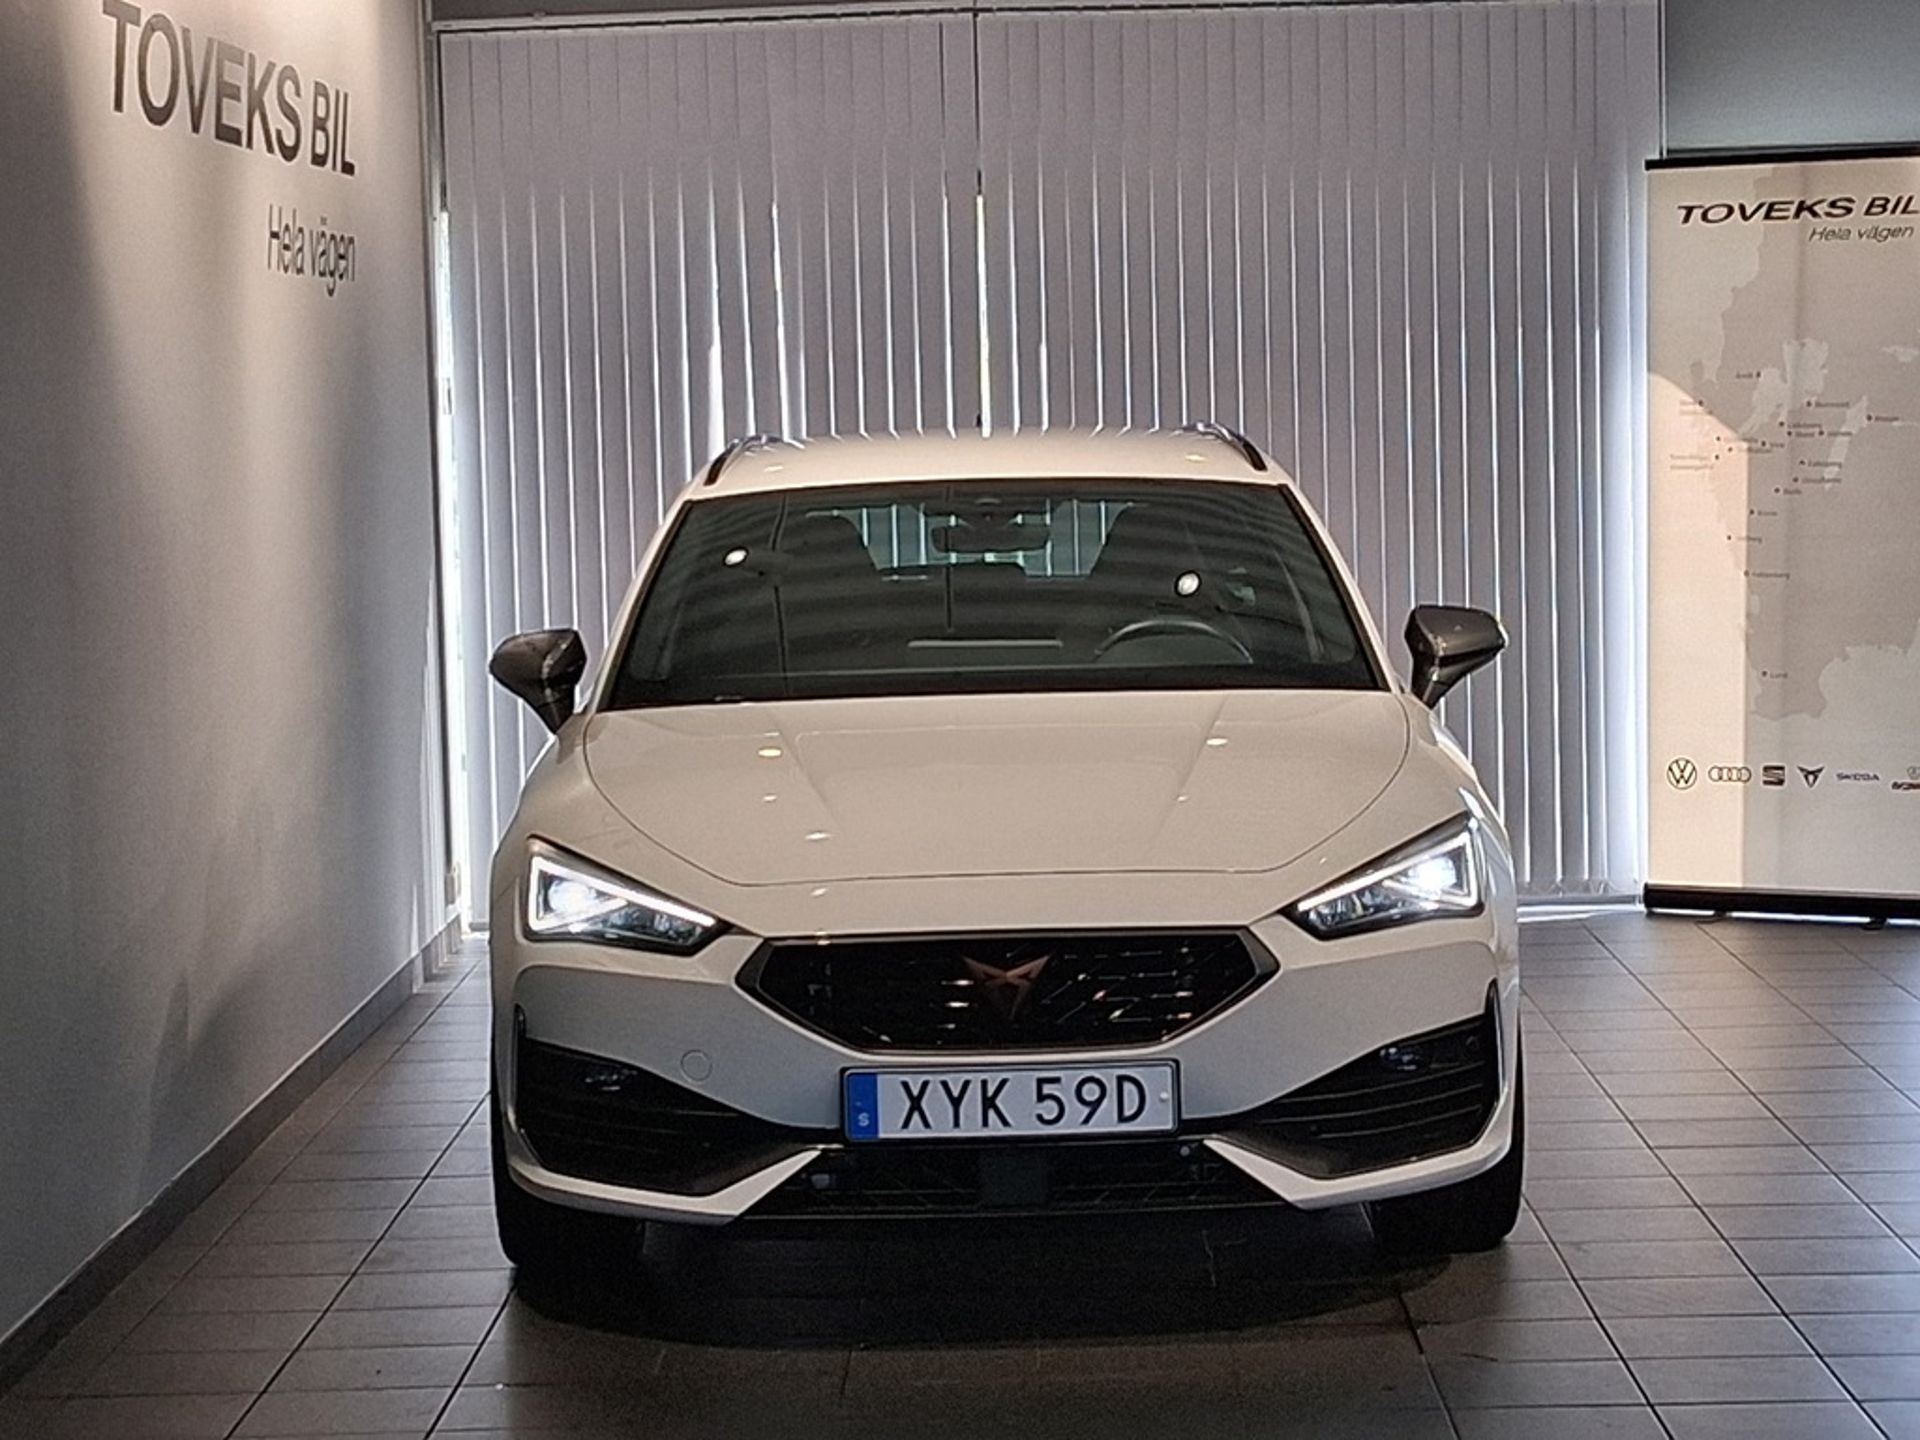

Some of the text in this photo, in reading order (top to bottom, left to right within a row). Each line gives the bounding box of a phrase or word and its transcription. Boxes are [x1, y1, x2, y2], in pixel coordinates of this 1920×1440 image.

[102, 0, 356, 177] TOVEKS BIL
[1677, 194, 1920, 225] TOVEKS BIL
[267, 203, 356, 297] Hela vägen
[1808, 225, 1914, 244] Hela vägen
[858, 1112, 870, 1127] S
[900, 1073, 1147, 1131] XYK 59D
